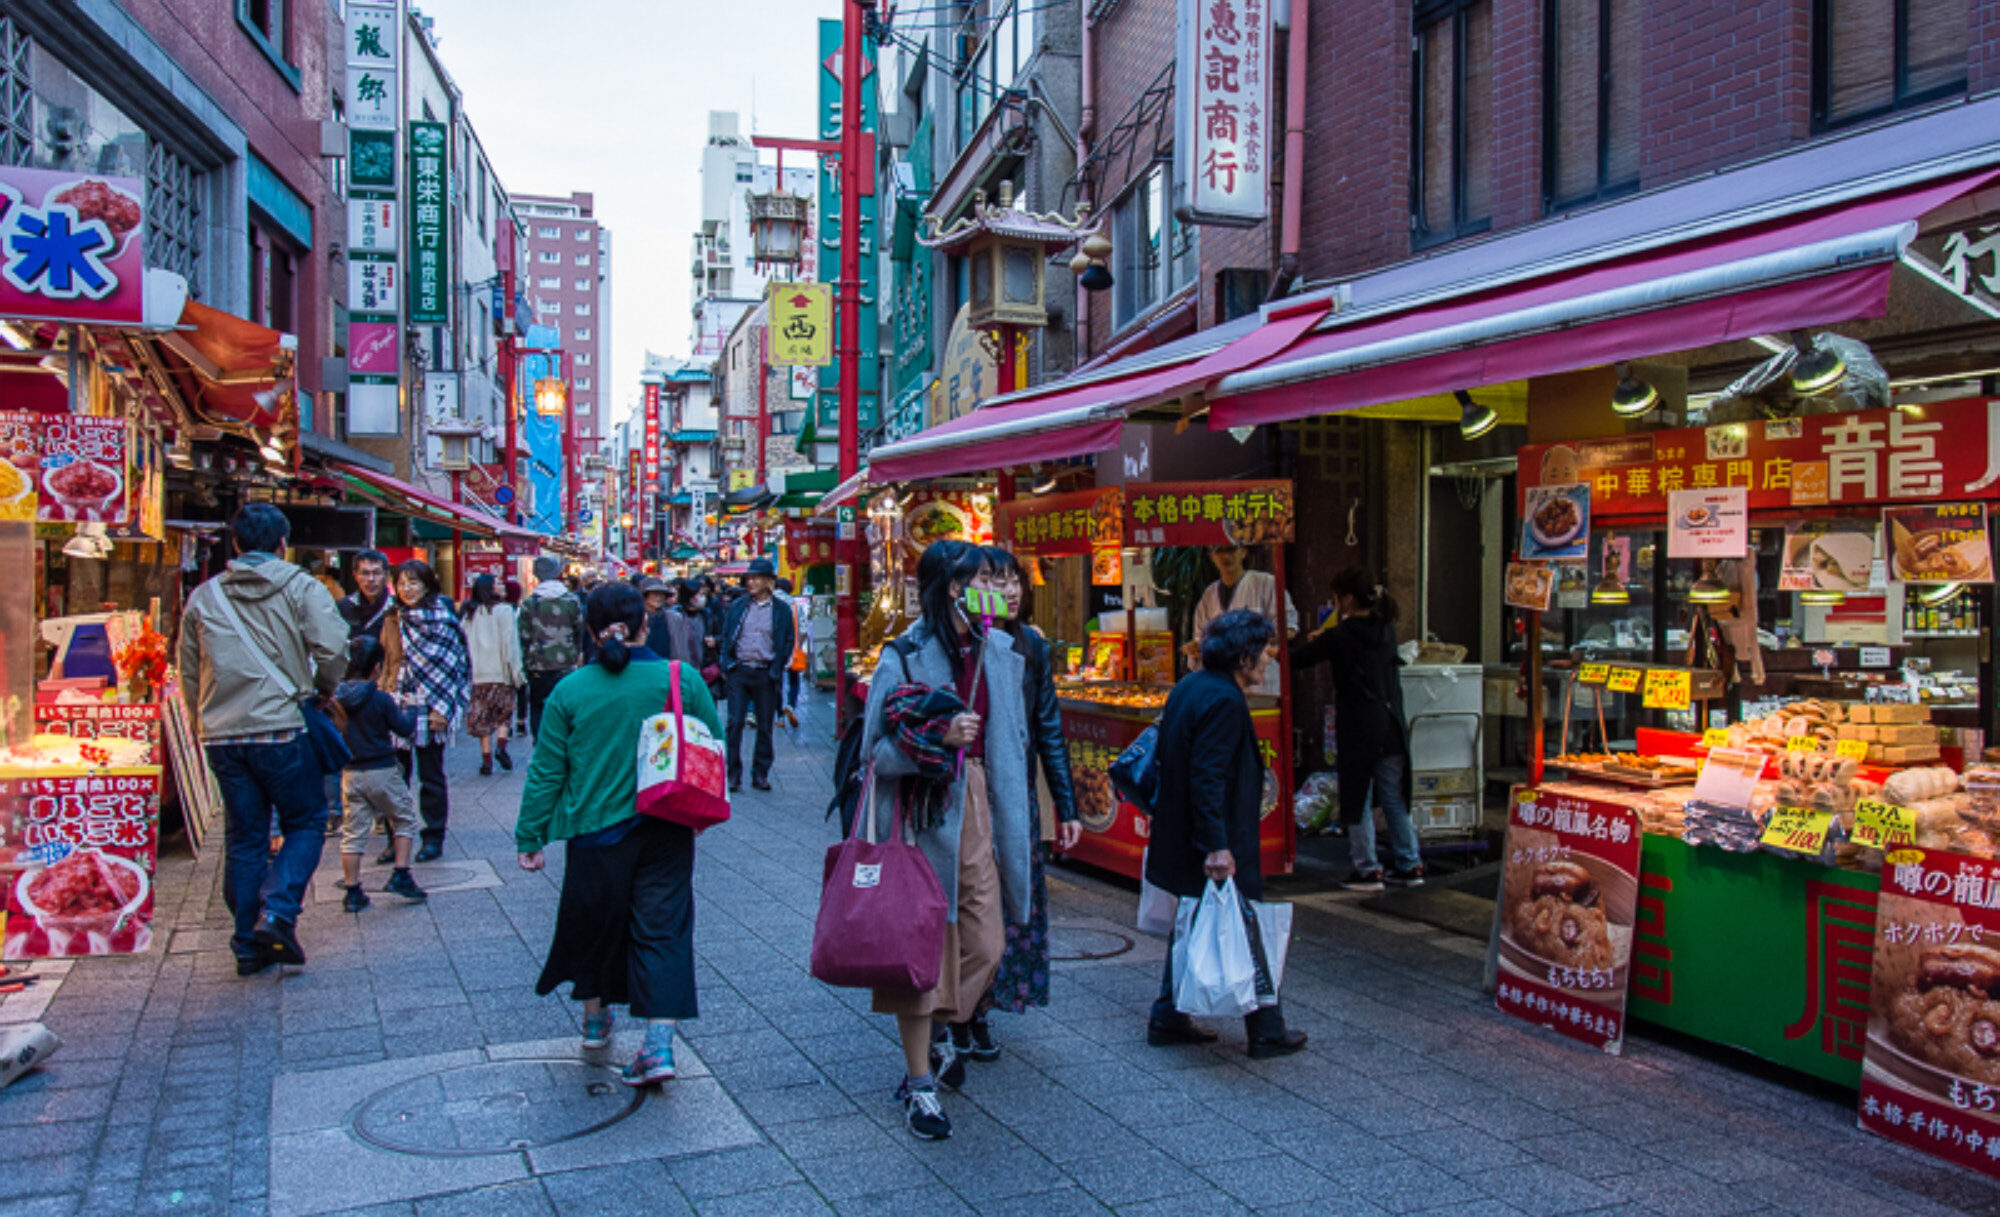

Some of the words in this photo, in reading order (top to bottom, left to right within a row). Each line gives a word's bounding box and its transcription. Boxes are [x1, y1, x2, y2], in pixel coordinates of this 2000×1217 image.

[10, 211, 107, 292] 氷
[783, 314, 816, 340] 西
[1132, 493, 1284, 525] 本格中華ポテト
[1014, 509, 1097, 544] 本格中華ポテト
[29, 793, 146, 823] まるごと
[25, 818, 149, 847] いちご氷
[1884, 921, 1984, 945] ホクホクで
